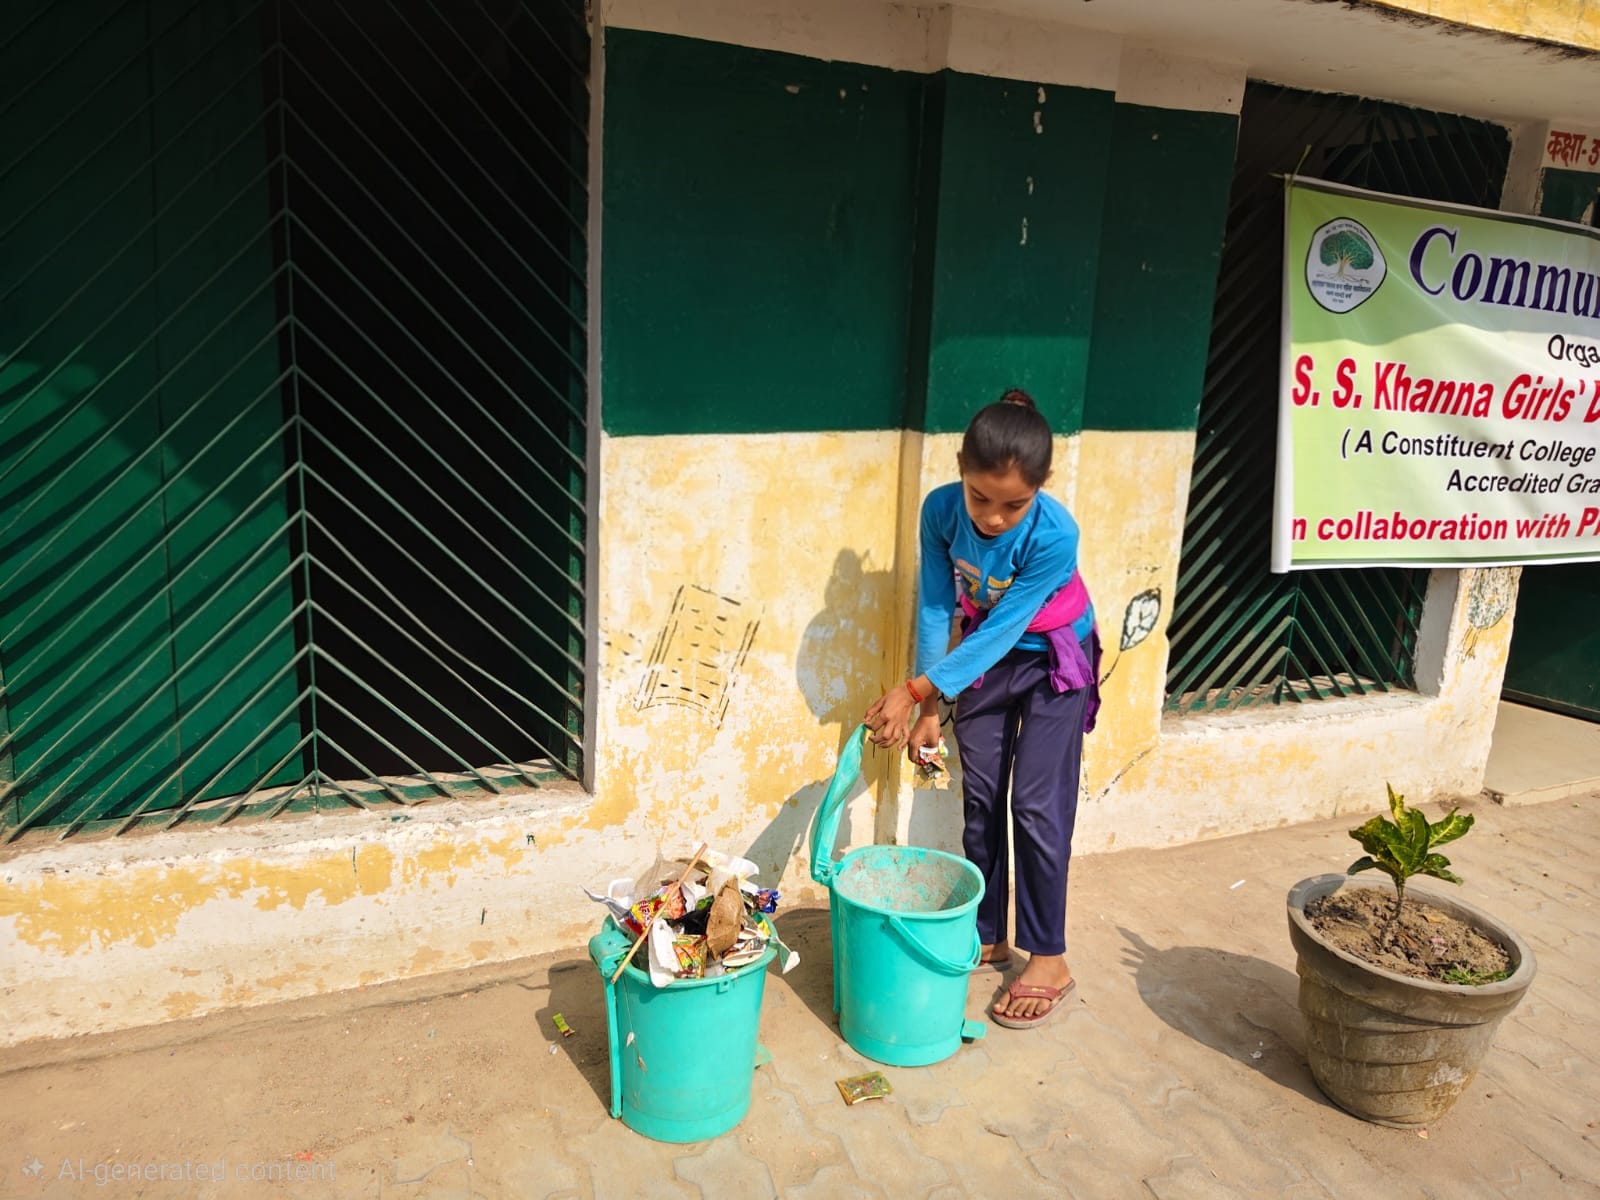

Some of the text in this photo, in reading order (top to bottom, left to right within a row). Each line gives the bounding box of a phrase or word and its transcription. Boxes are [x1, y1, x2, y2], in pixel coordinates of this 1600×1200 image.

[1292, 355, 1319, 406] S.
[1333, 358, 1362, 408] S.
[1374, 361, 1495, 418] Khanna
[1502, 373, 1586, 422] Girls'
[1355, 430, 1372, 454] A
[1382, 431, 1514, 460] Constituent
[1519, 440, 1596, 468] College
[1447, 469, 1564, 494] Accredited
[1317, 511, 1508, 541] collaboration
[1516, 513, 1571, 539] with
